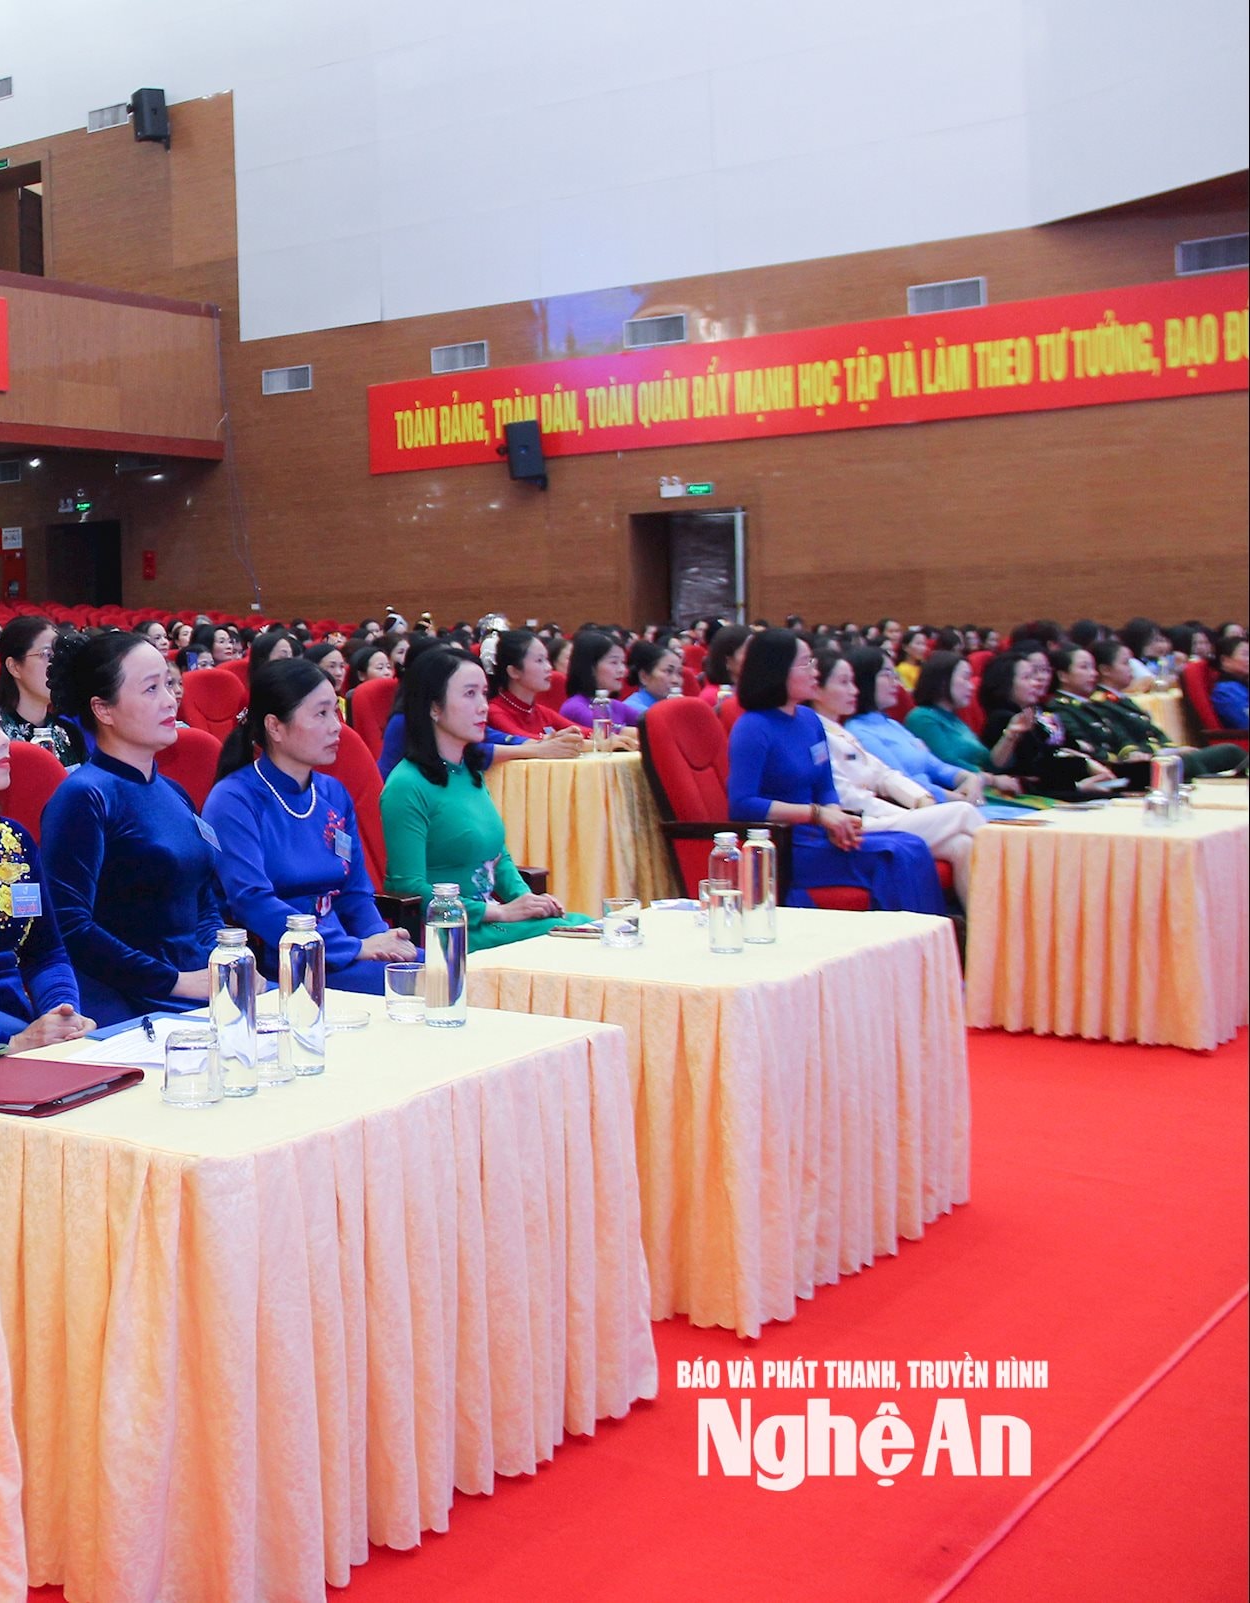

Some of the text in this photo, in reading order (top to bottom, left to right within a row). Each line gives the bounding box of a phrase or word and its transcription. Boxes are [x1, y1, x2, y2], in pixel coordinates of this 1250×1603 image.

[394, 400, 437, 450] TOÀN
[439, 390, 490, 446] ĐẢNG,
[492, 387, 538, 440] TOÀN
[540, 383, 583, 436] DÂN,
[586, 375, 634, 430] TOÀN
[638, 370, 690, 429] QUÂN
[691, 356, 731, 419] ĐẨY
[734, 365, 796, 423] MẠNH
[797, 359, 841, 416] HỌC
[843, 346, 885, 412] TẬP
[887, 341, 919, 398] VÀ
[921, 337, 971, 395] LÀM
[973, 336, 1034, 389] THEO
[1035, 327, 1069, 382] TƯ
[1070, 309, 1161, 378] TƯỞNG,
[1164, 313, 1219, 378] ĐẠO
